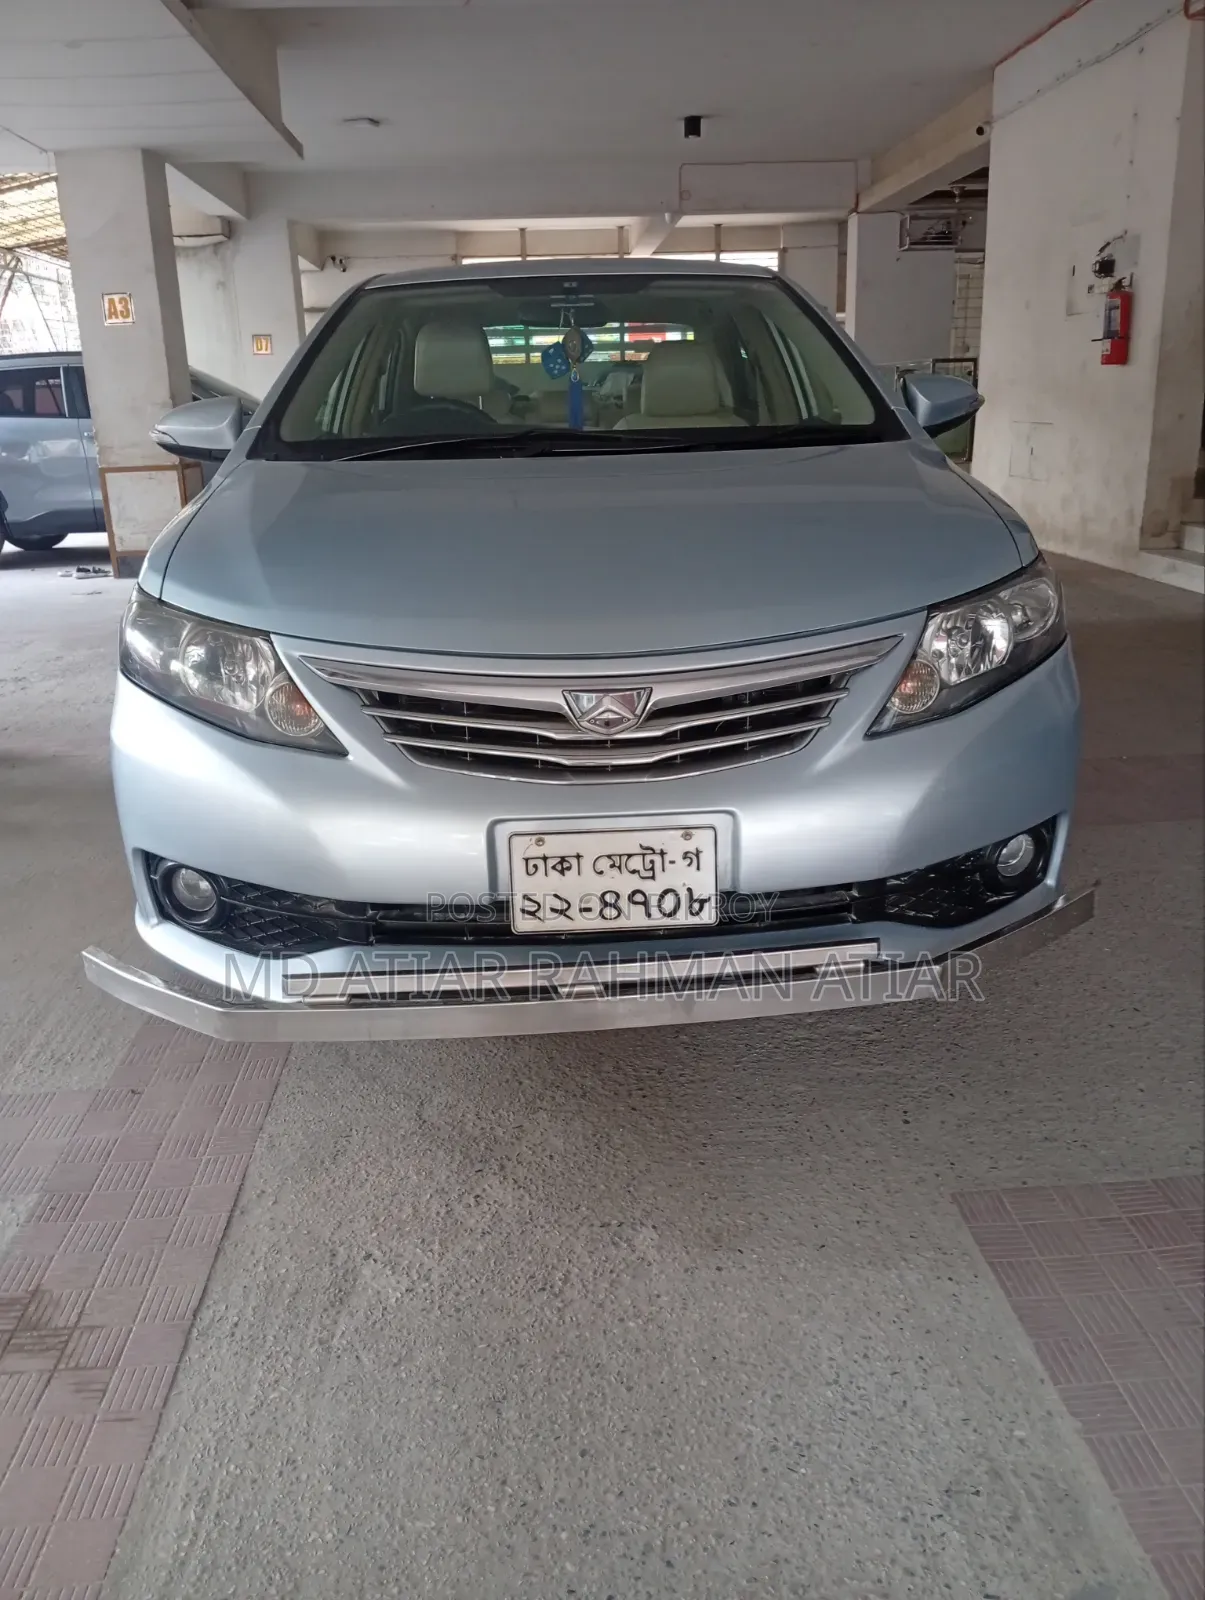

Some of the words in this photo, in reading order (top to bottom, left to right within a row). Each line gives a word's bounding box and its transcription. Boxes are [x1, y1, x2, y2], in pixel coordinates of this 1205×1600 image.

[107, 296, 131, 320] A3
[522, 852, 583, 877] ঢাকা
[519, 886, 711, 922] ২২-৪৭০৮
